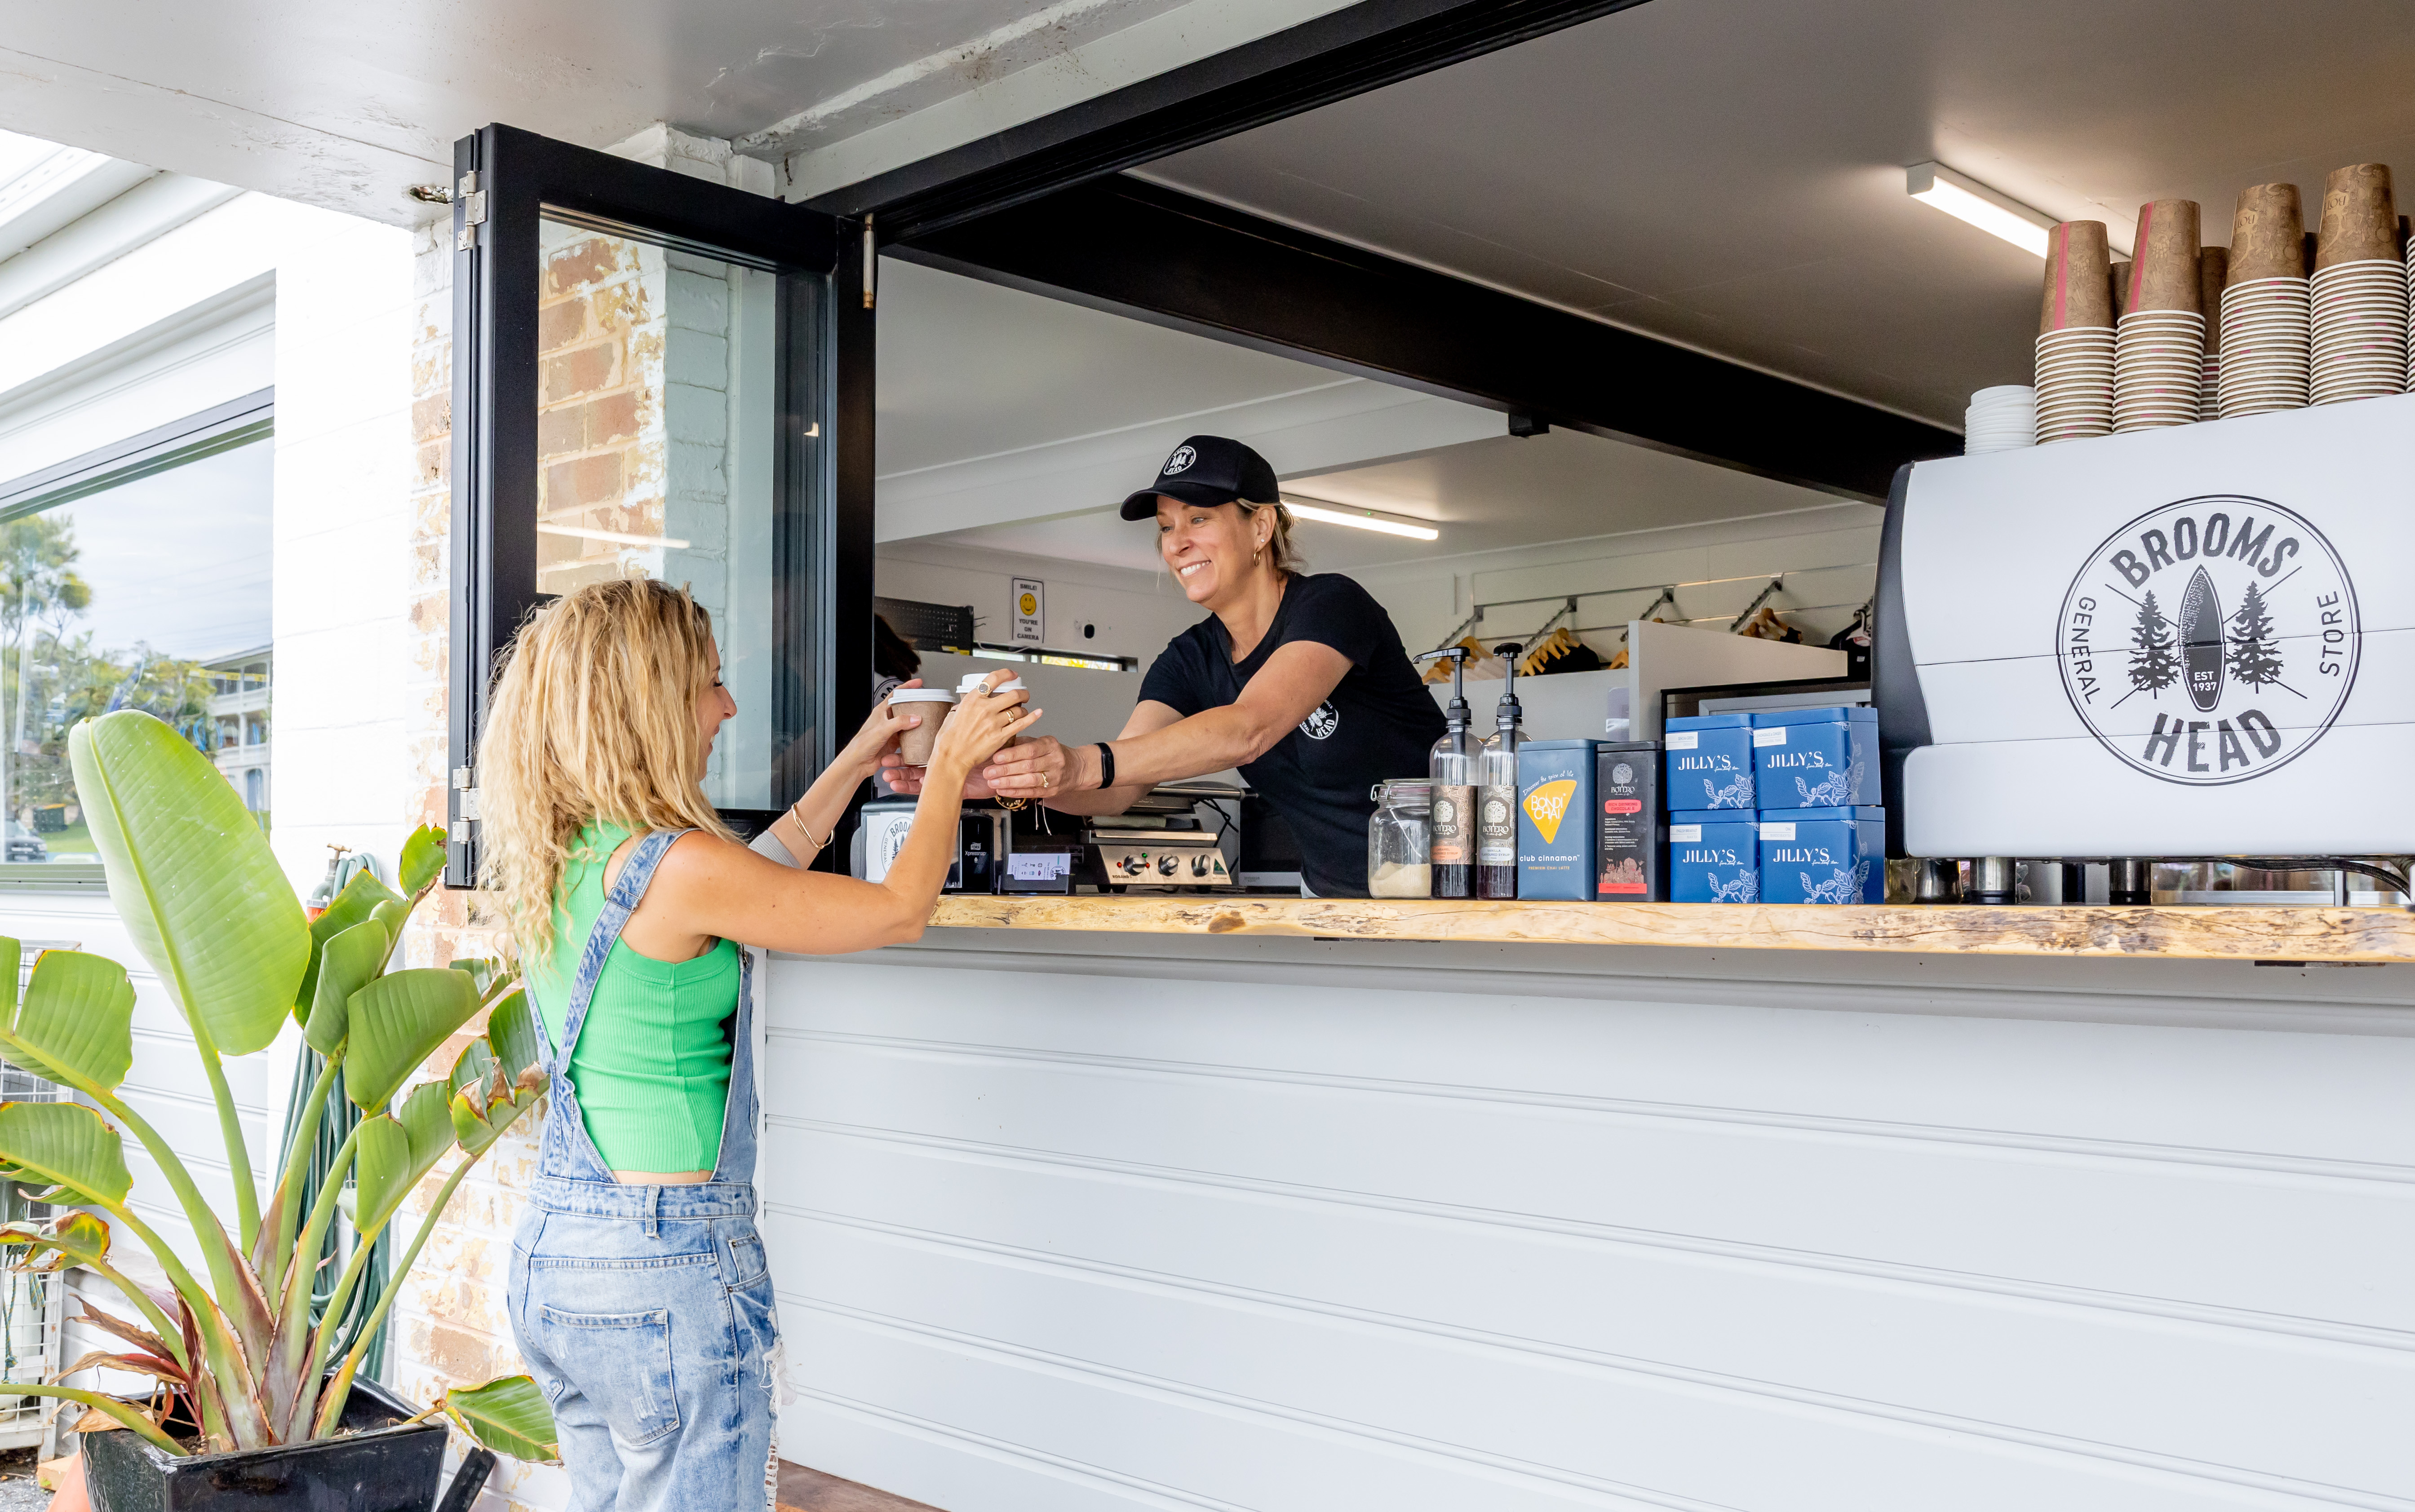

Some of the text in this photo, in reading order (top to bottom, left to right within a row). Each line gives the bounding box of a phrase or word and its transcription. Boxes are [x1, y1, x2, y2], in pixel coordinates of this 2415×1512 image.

[2325, 195, 2346, 210] BOT
[2236, 214, 2255, 228] BOT
[2109, 513, 2300, 589] BROOMS
[2317, 590, 2344, 676] STORE
[2072, 597, 2100, 704] GENERAL
[2194, 671, 2214, 681] EST
[2193, 681, 2217, 691] 1937
[1316, 719, 1335, 737] HEAD
[2142, 709, 2282, 772] HEAD
[1678, 755, 1731, 770] JILLY'S
[1768, 751, 1823, 768] JILLY'S
[1522, 780, 1540, 796] Discover
[1531, 795, 1563, 810] BONDI
[1534, 808, 1560, 820] CHAI
[890, 822, 910, 837] BROO
[1483, 826, 1509, 834] BOTERO
[1683, 849, 1735, 863] JILLY'S
[1773, 848, 1830, 862] JILLY'S
